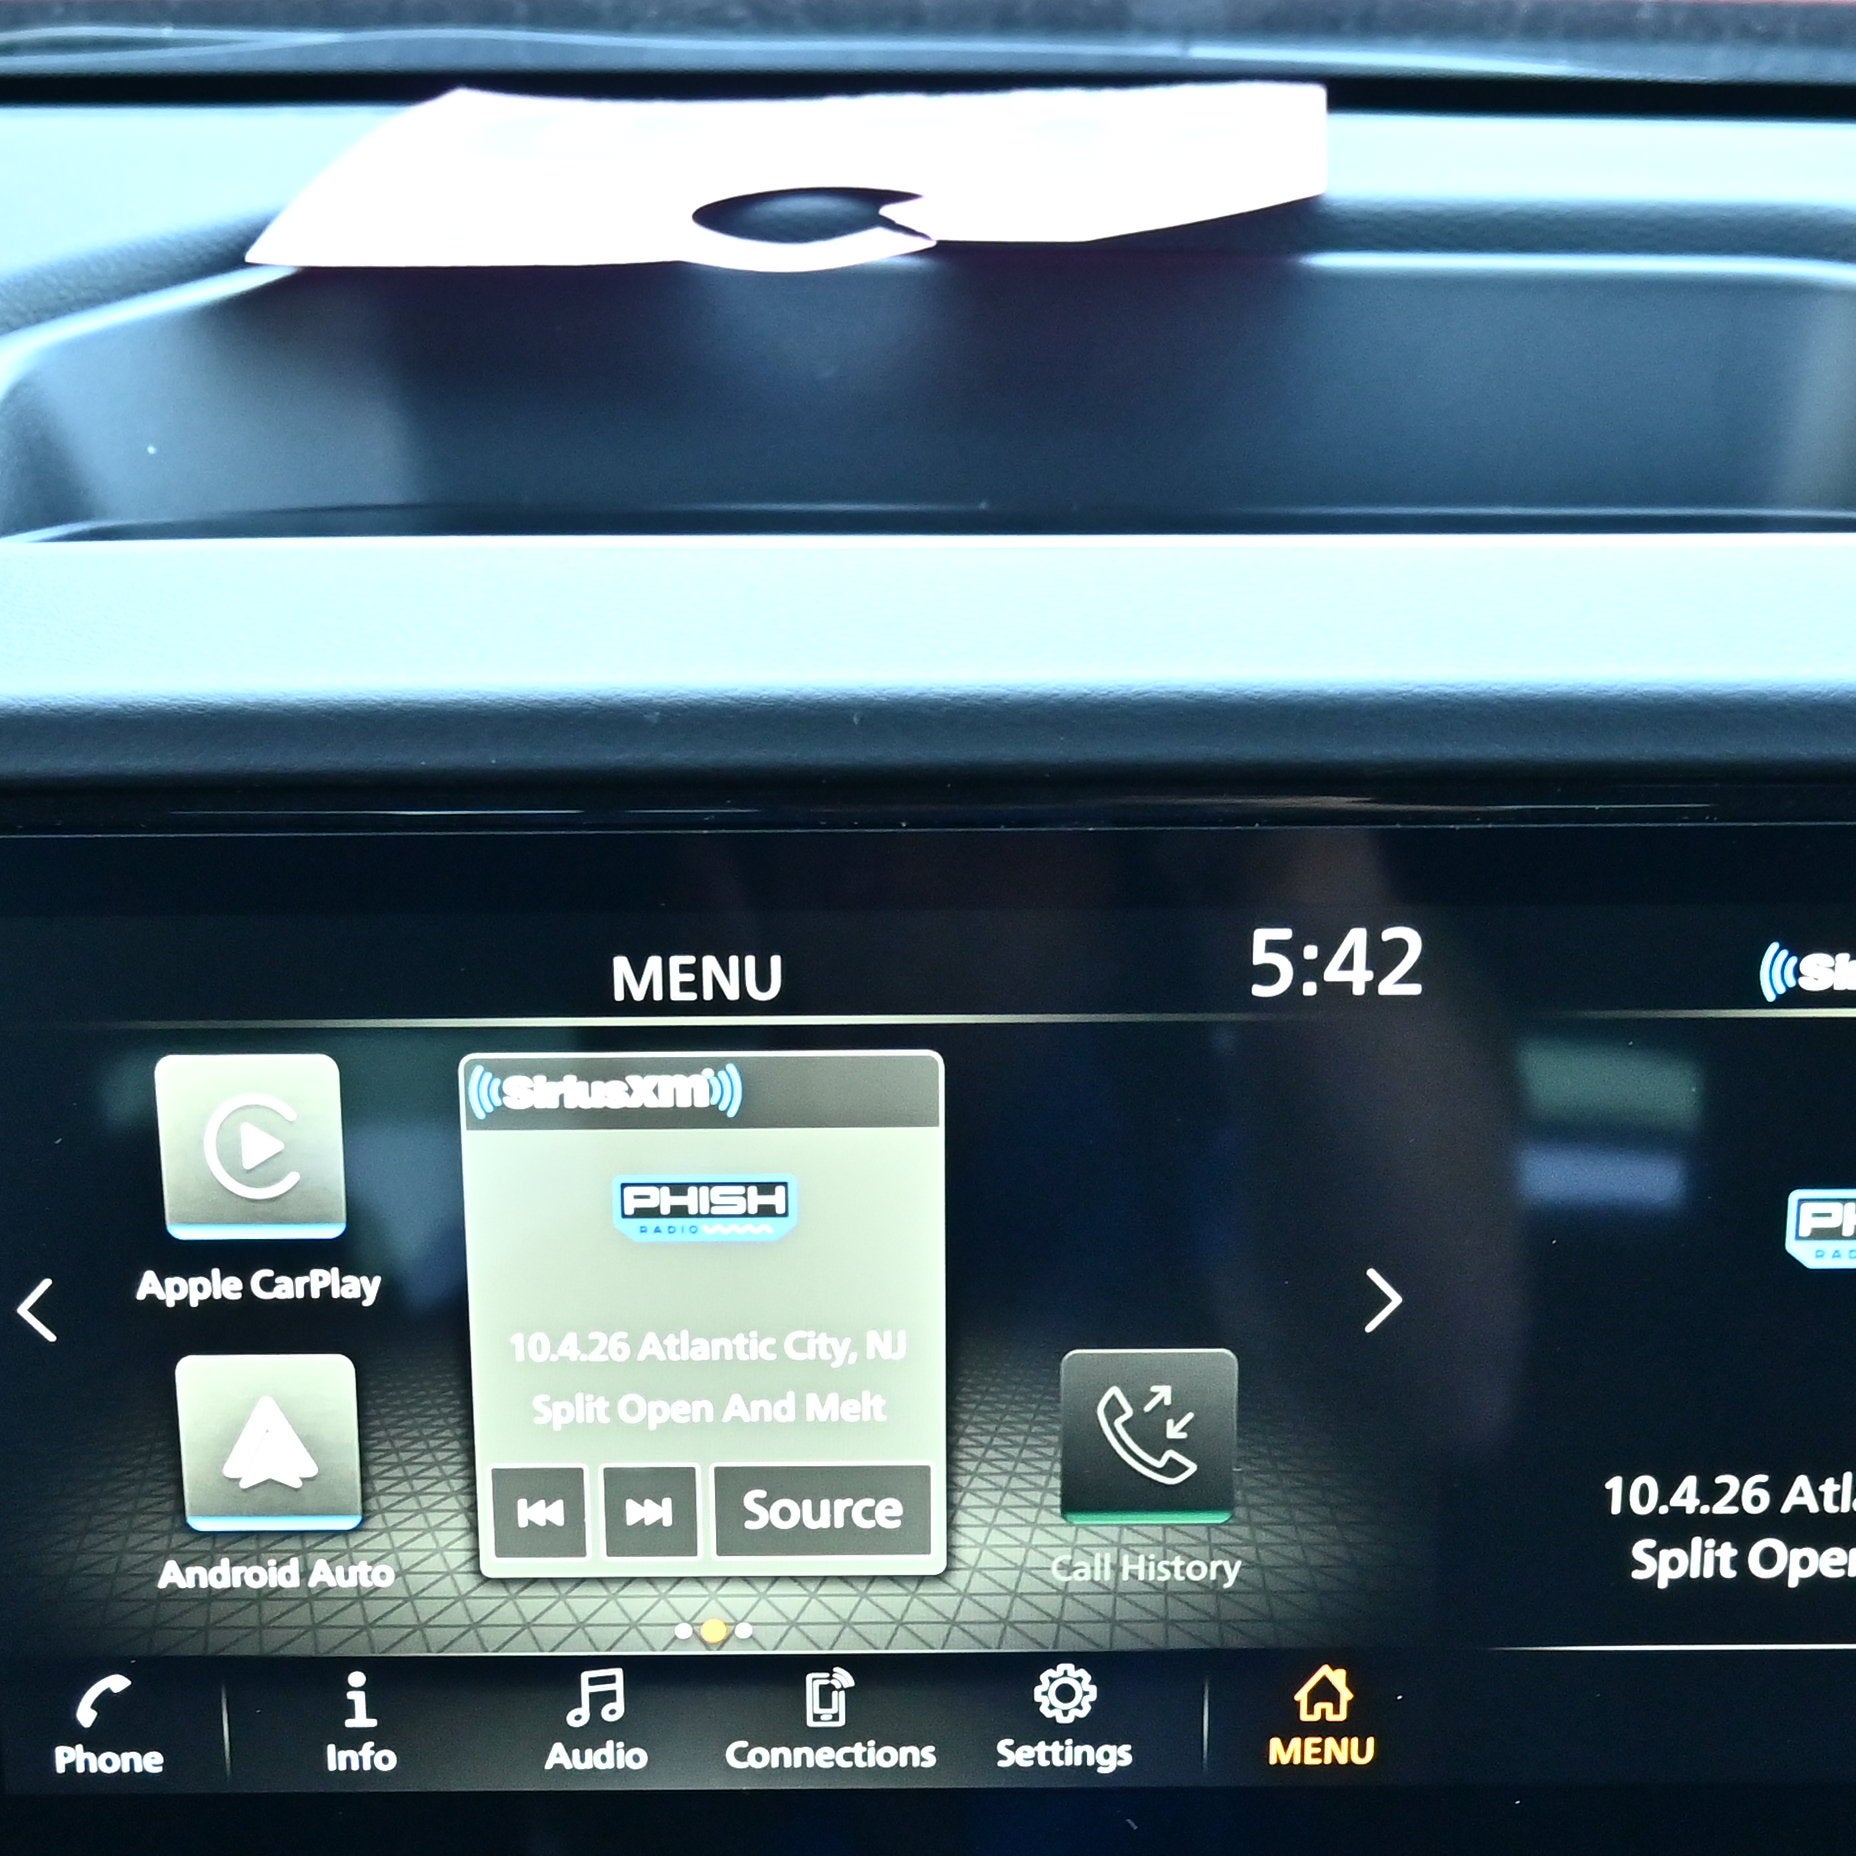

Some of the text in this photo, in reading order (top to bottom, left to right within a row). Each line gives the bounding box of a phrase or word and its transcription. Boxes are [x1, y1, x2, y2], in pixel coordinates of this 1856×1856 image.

[611, 954, 783, 1002] MENU
[1249, 926, 1425, 997] 5:42
[622, 1184, 787, 1217] PHISH
[639, 1225, 698, 1235] RADIO
[136, 1268, 382, 1307] Apple CarPlay
[509, 1329, 907, 1369] 10.4.26 Atlantic City, NJ
[532, 1392, 887, 1431] Split Open And Melt
[743, 1490, 904, 1532] Source
[1604, 1474, 1771, 1516] 10.4.26
[157, 1558, 396, 1590] Android Auto
[1050, 1554, 1243, 1589] Call History
[1631, 1537, 1737, 1589] Split
[54, 1744, 164, 1776] Phone
[326, 1742, 398, 1773] Info
[544, 1741, 648, 1771] Audio
[724, 1738, 937, 1771] Connections
[996, 1737, 1134, 1775] Settings
[1267, 1735, 1376, 1766] MENU
